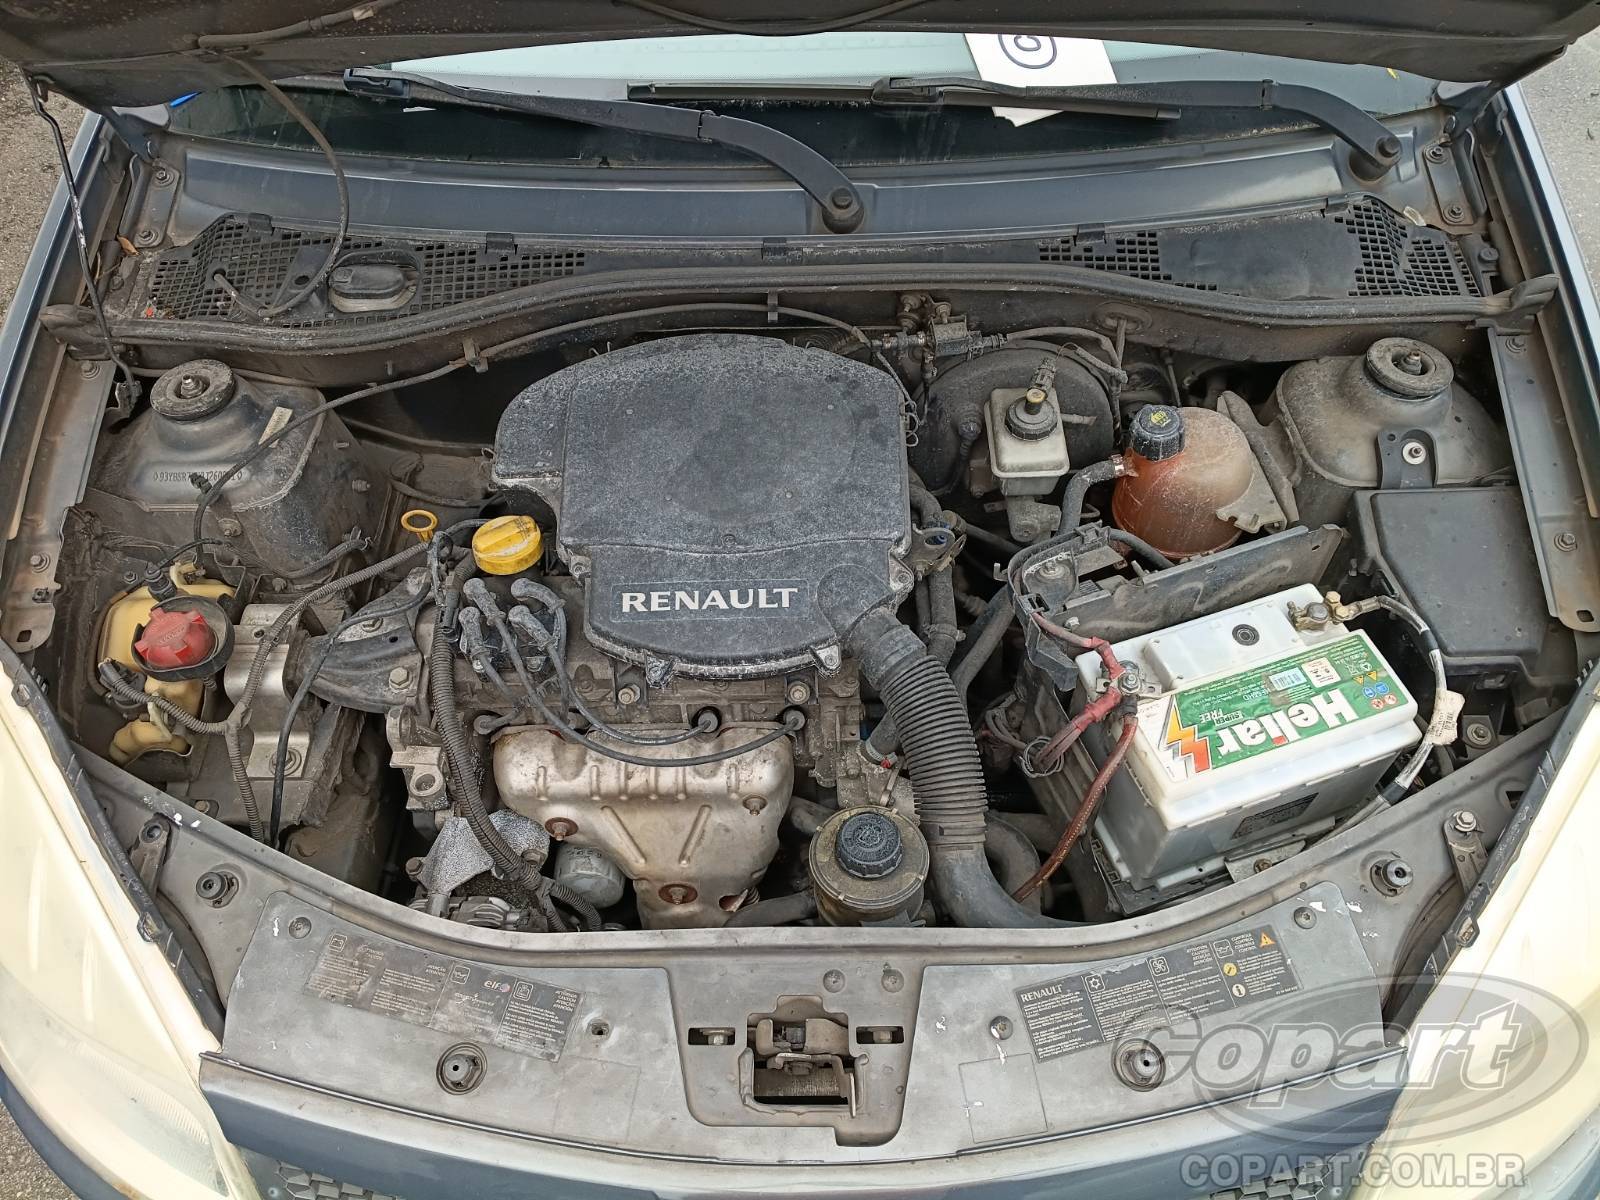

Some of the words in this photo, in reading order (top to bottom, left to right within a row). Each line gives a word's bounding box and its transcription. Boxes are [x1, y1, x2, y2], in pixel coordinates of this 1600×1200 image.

[621, 587, 798, 613] RENAULT
[1199, 708, 1223, 724] FREE
[1215, 711, 1241, 725] SUPER
[1215, 688, 1359, 757] Heliar
[483, 980, 502, 990] elf
[1020, 984, 1063, 1003] RENAULT
